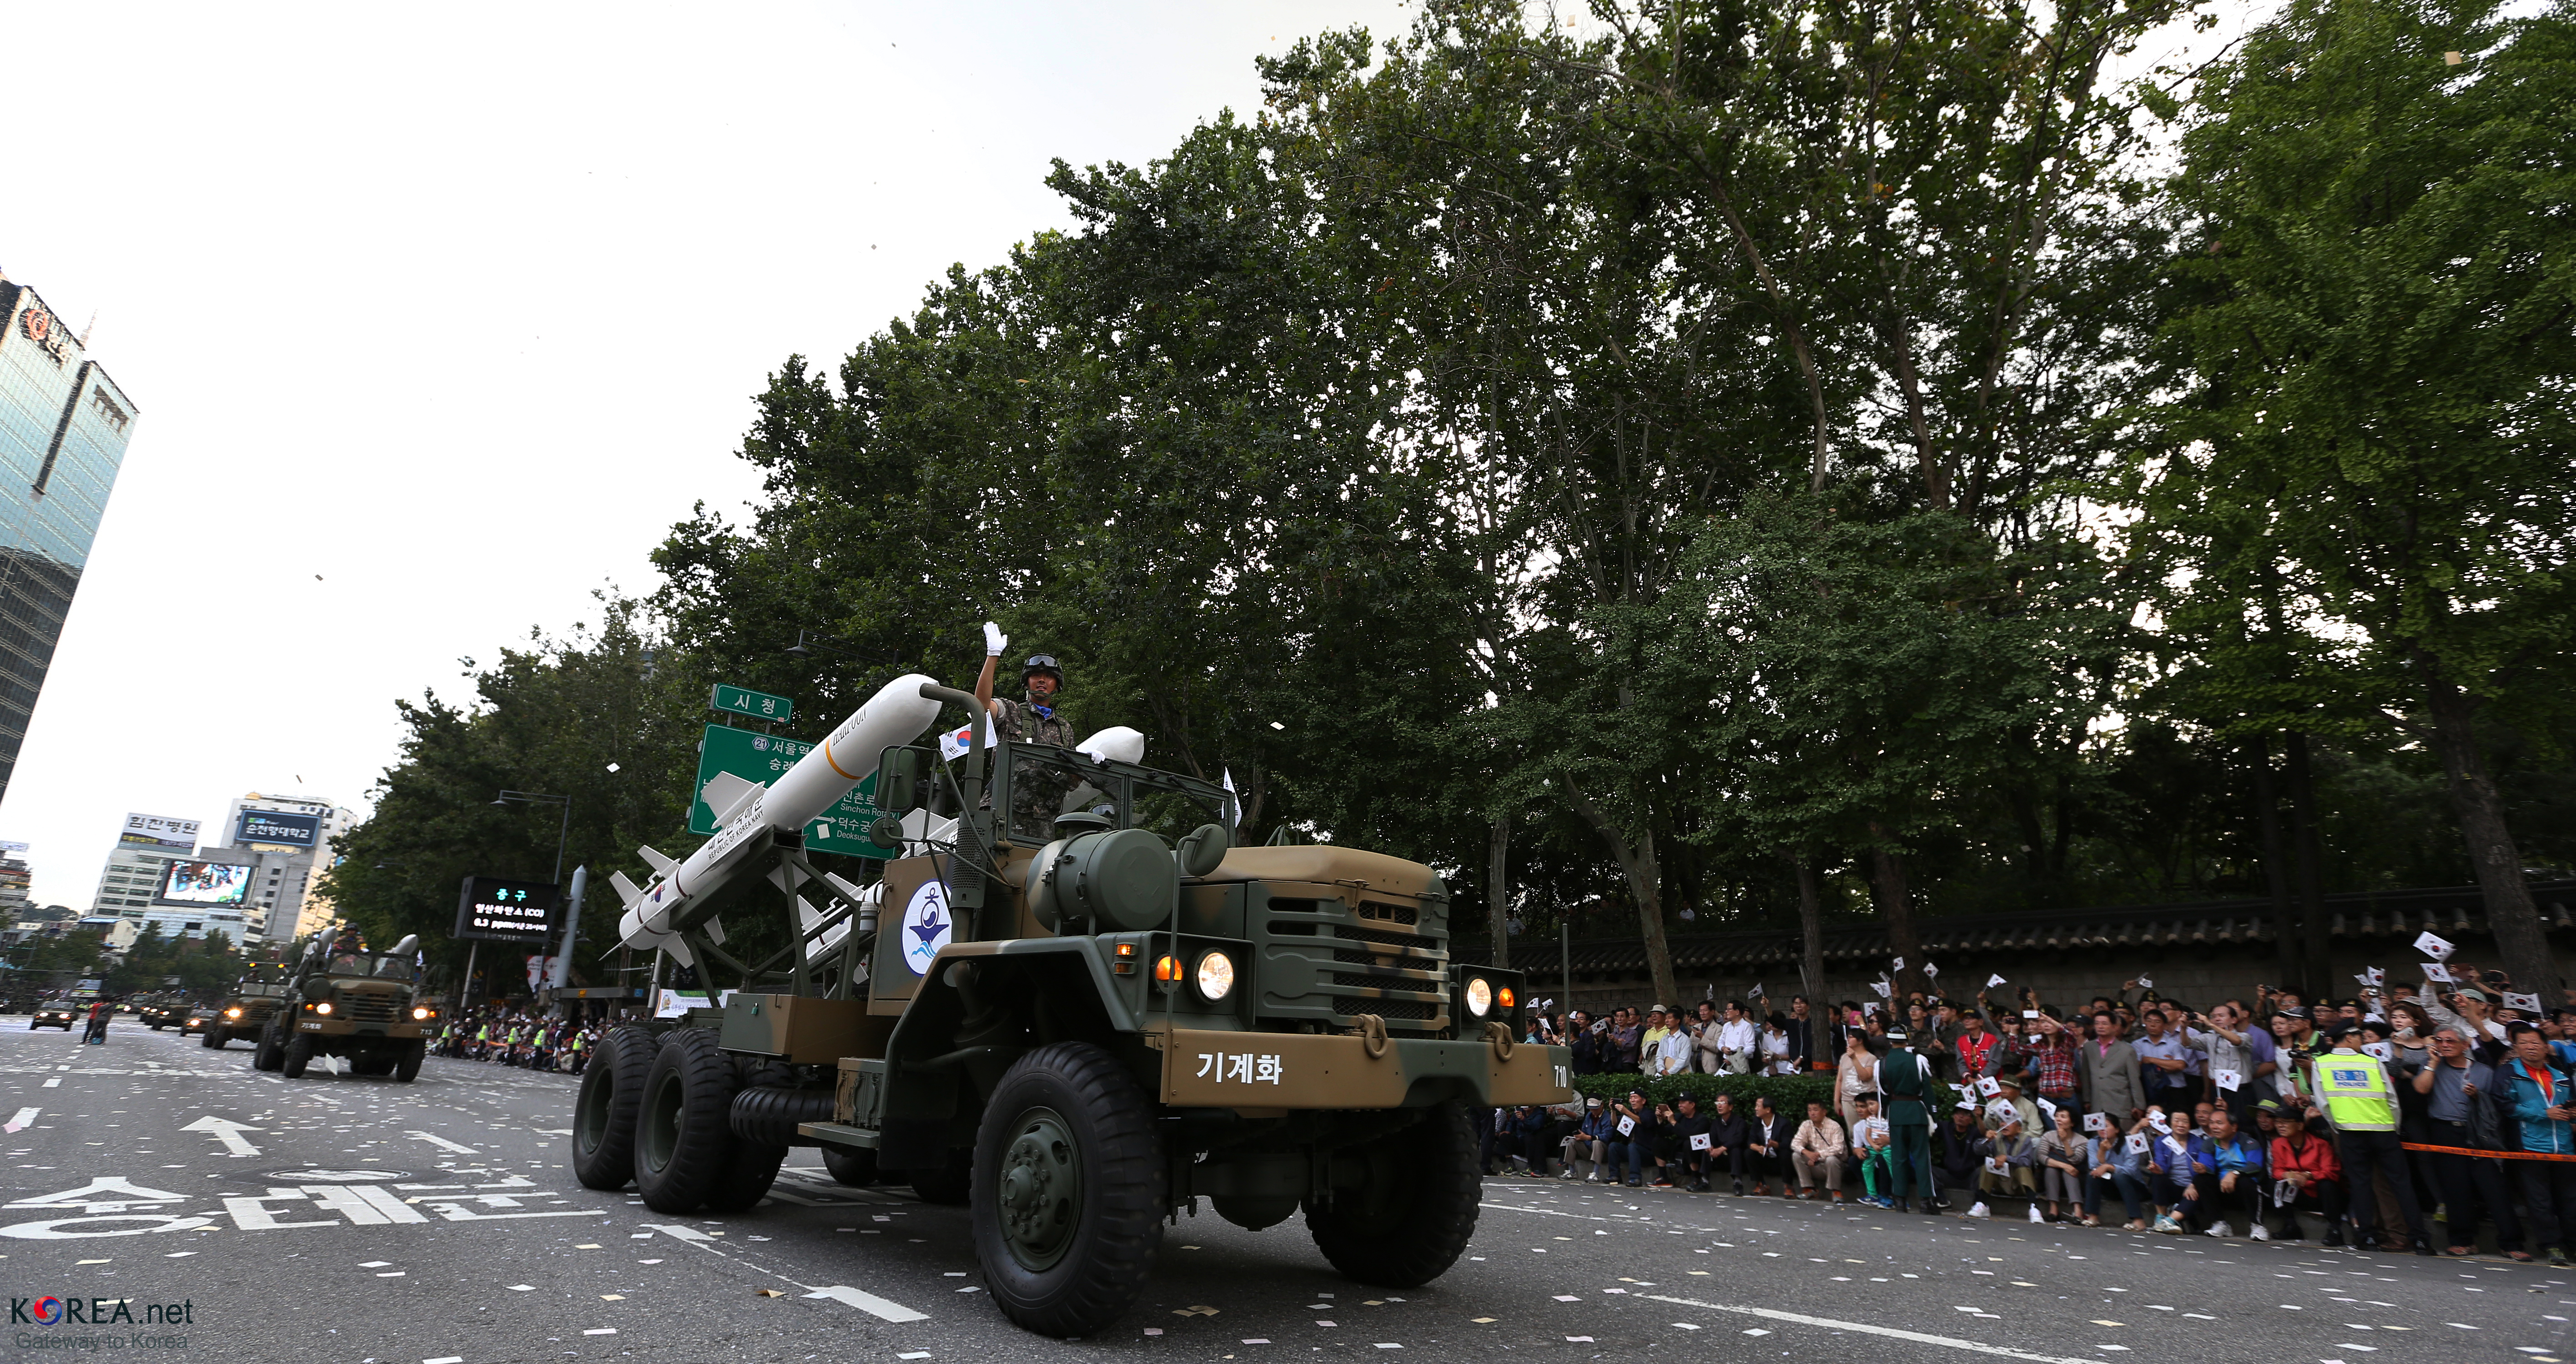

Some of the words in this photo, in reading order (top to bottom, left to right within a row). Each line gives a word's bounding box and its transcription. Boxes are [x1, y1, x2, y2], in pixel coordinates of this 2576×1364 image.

[833, 706, 867, 747] HARPOON
[755, 739, 766, 748] 21
[772, 741, 810, 756] 서울역
[770, 758, 795, 771] 숭례
[843, 791, 875, 806] 신촌로
[840, 803, 870, 815] Sinchon
[871, 807, 896, 818] Rotay
[129, 816, 199, 835] 힘찬병원
[246, 824, 310, 838] 순천향대학교
[838, 817, 870, 832] 덕수궁
[708, 839, 729, 860] REPUBLIC
[736, 821, 752, 837] KOREA
[751, 809, 764, 824] NAVY
[837, 830, 871, 843] Deoksugu
[1196, 1052, 1283, 1085] 기계화
[1554, 1065, 1567, 1088] 710
